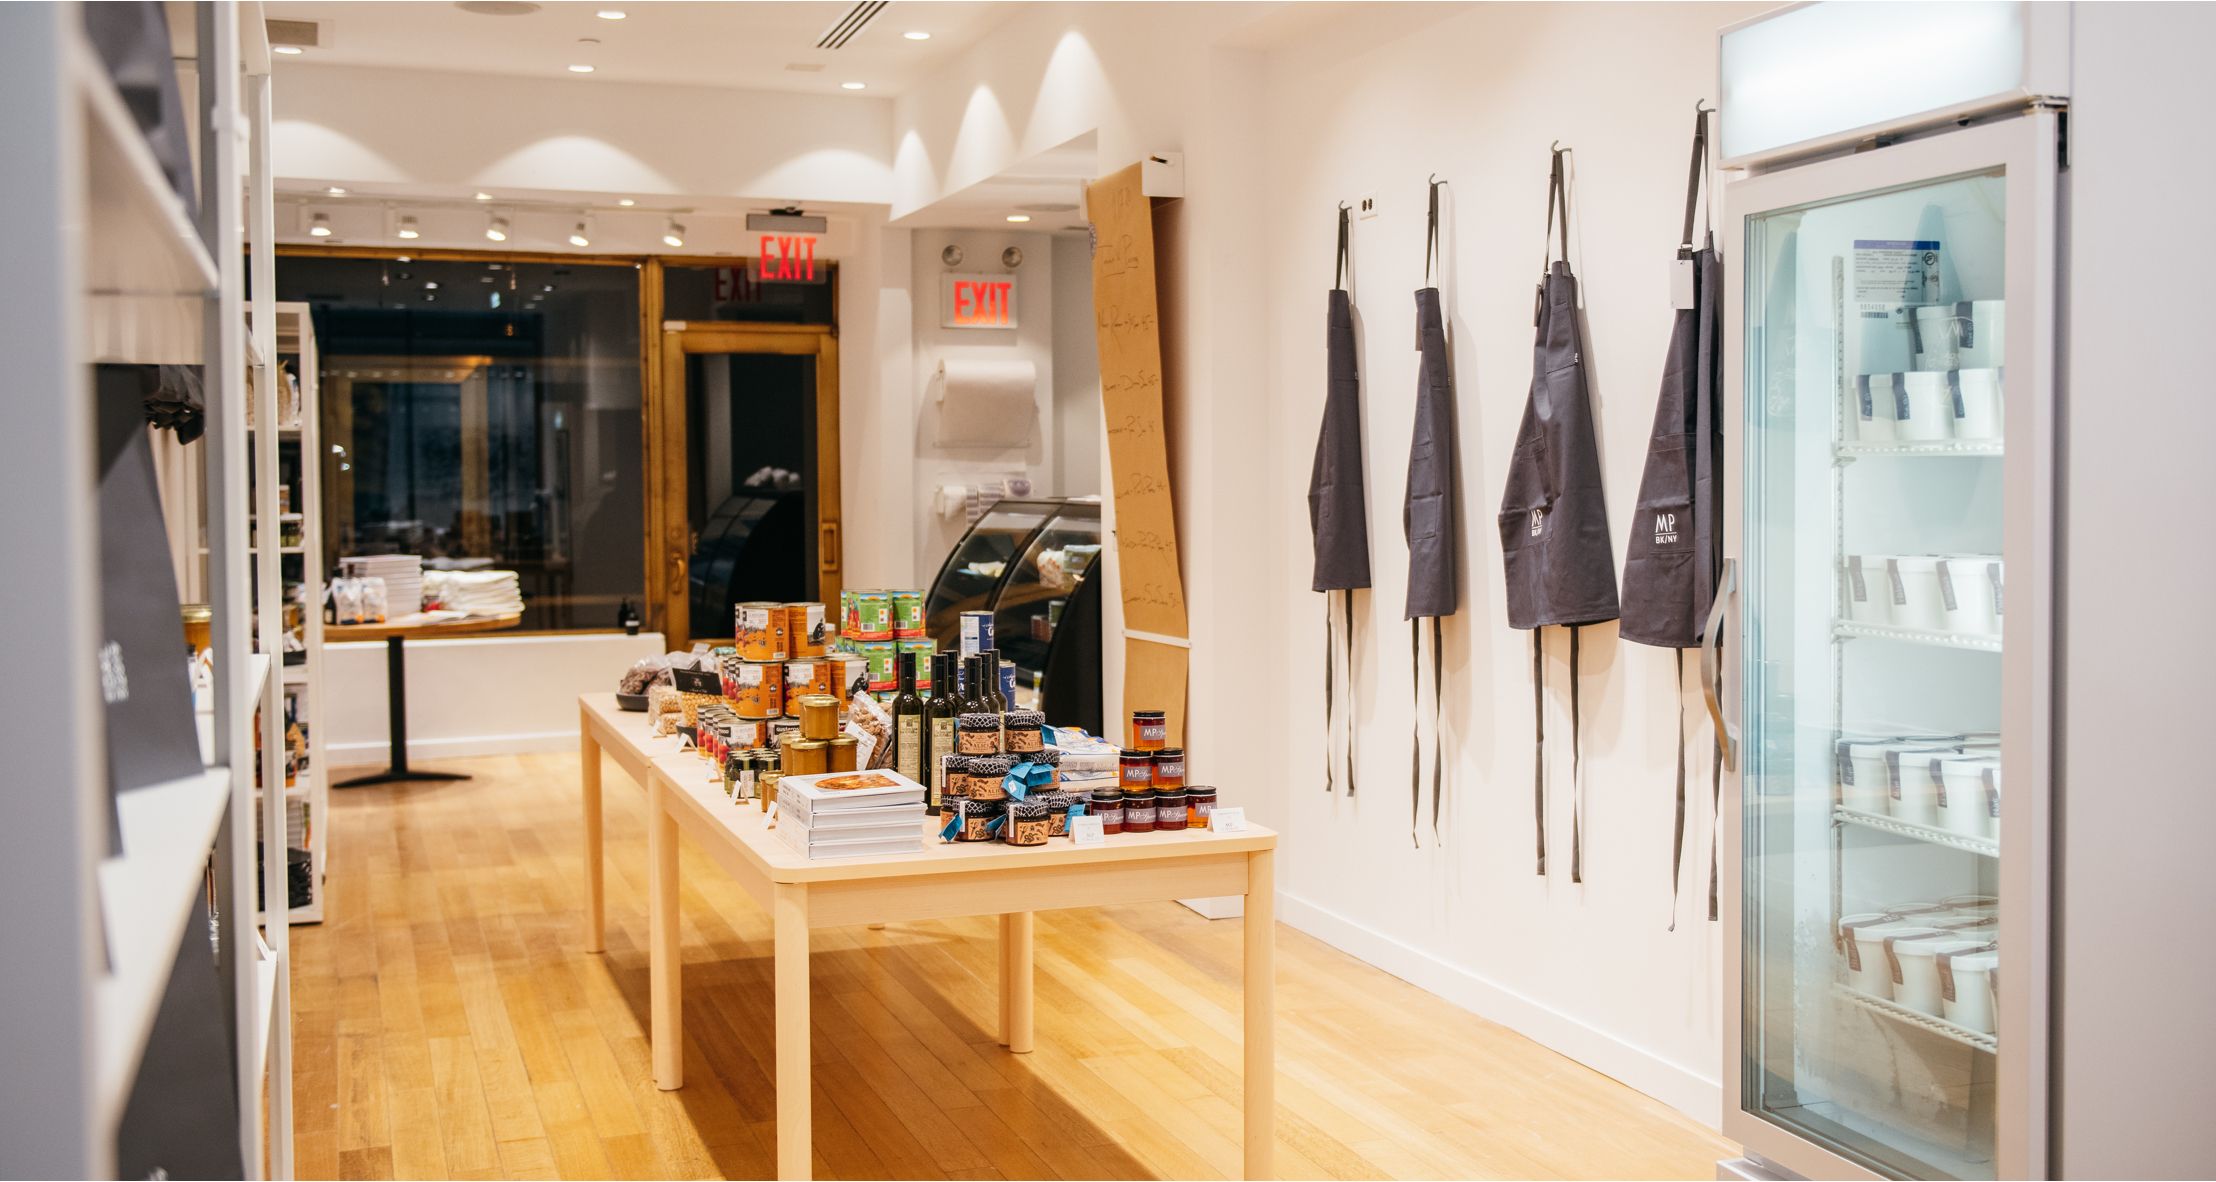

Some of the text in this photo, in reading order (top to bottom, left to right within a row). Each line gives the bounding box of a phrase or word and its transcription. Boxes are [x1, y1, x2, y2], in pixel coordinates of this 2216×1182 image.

[759, 235, 817, 281] EXIT
[953, 280, 1013, 326] EXIT
[1531, 509, 1543, 526] MP
[1655, 513, 1676, 533] MP
[1655, 534, 1678, 544] BK/NY
[1143, 728, 1157, 737] MP
[1126, 769, 1139, 778] MP
[1161, 765, 1174, 774] MP
[1128, 811, 1141, 820] MP
[1159, 809, 1172, 819] MP
